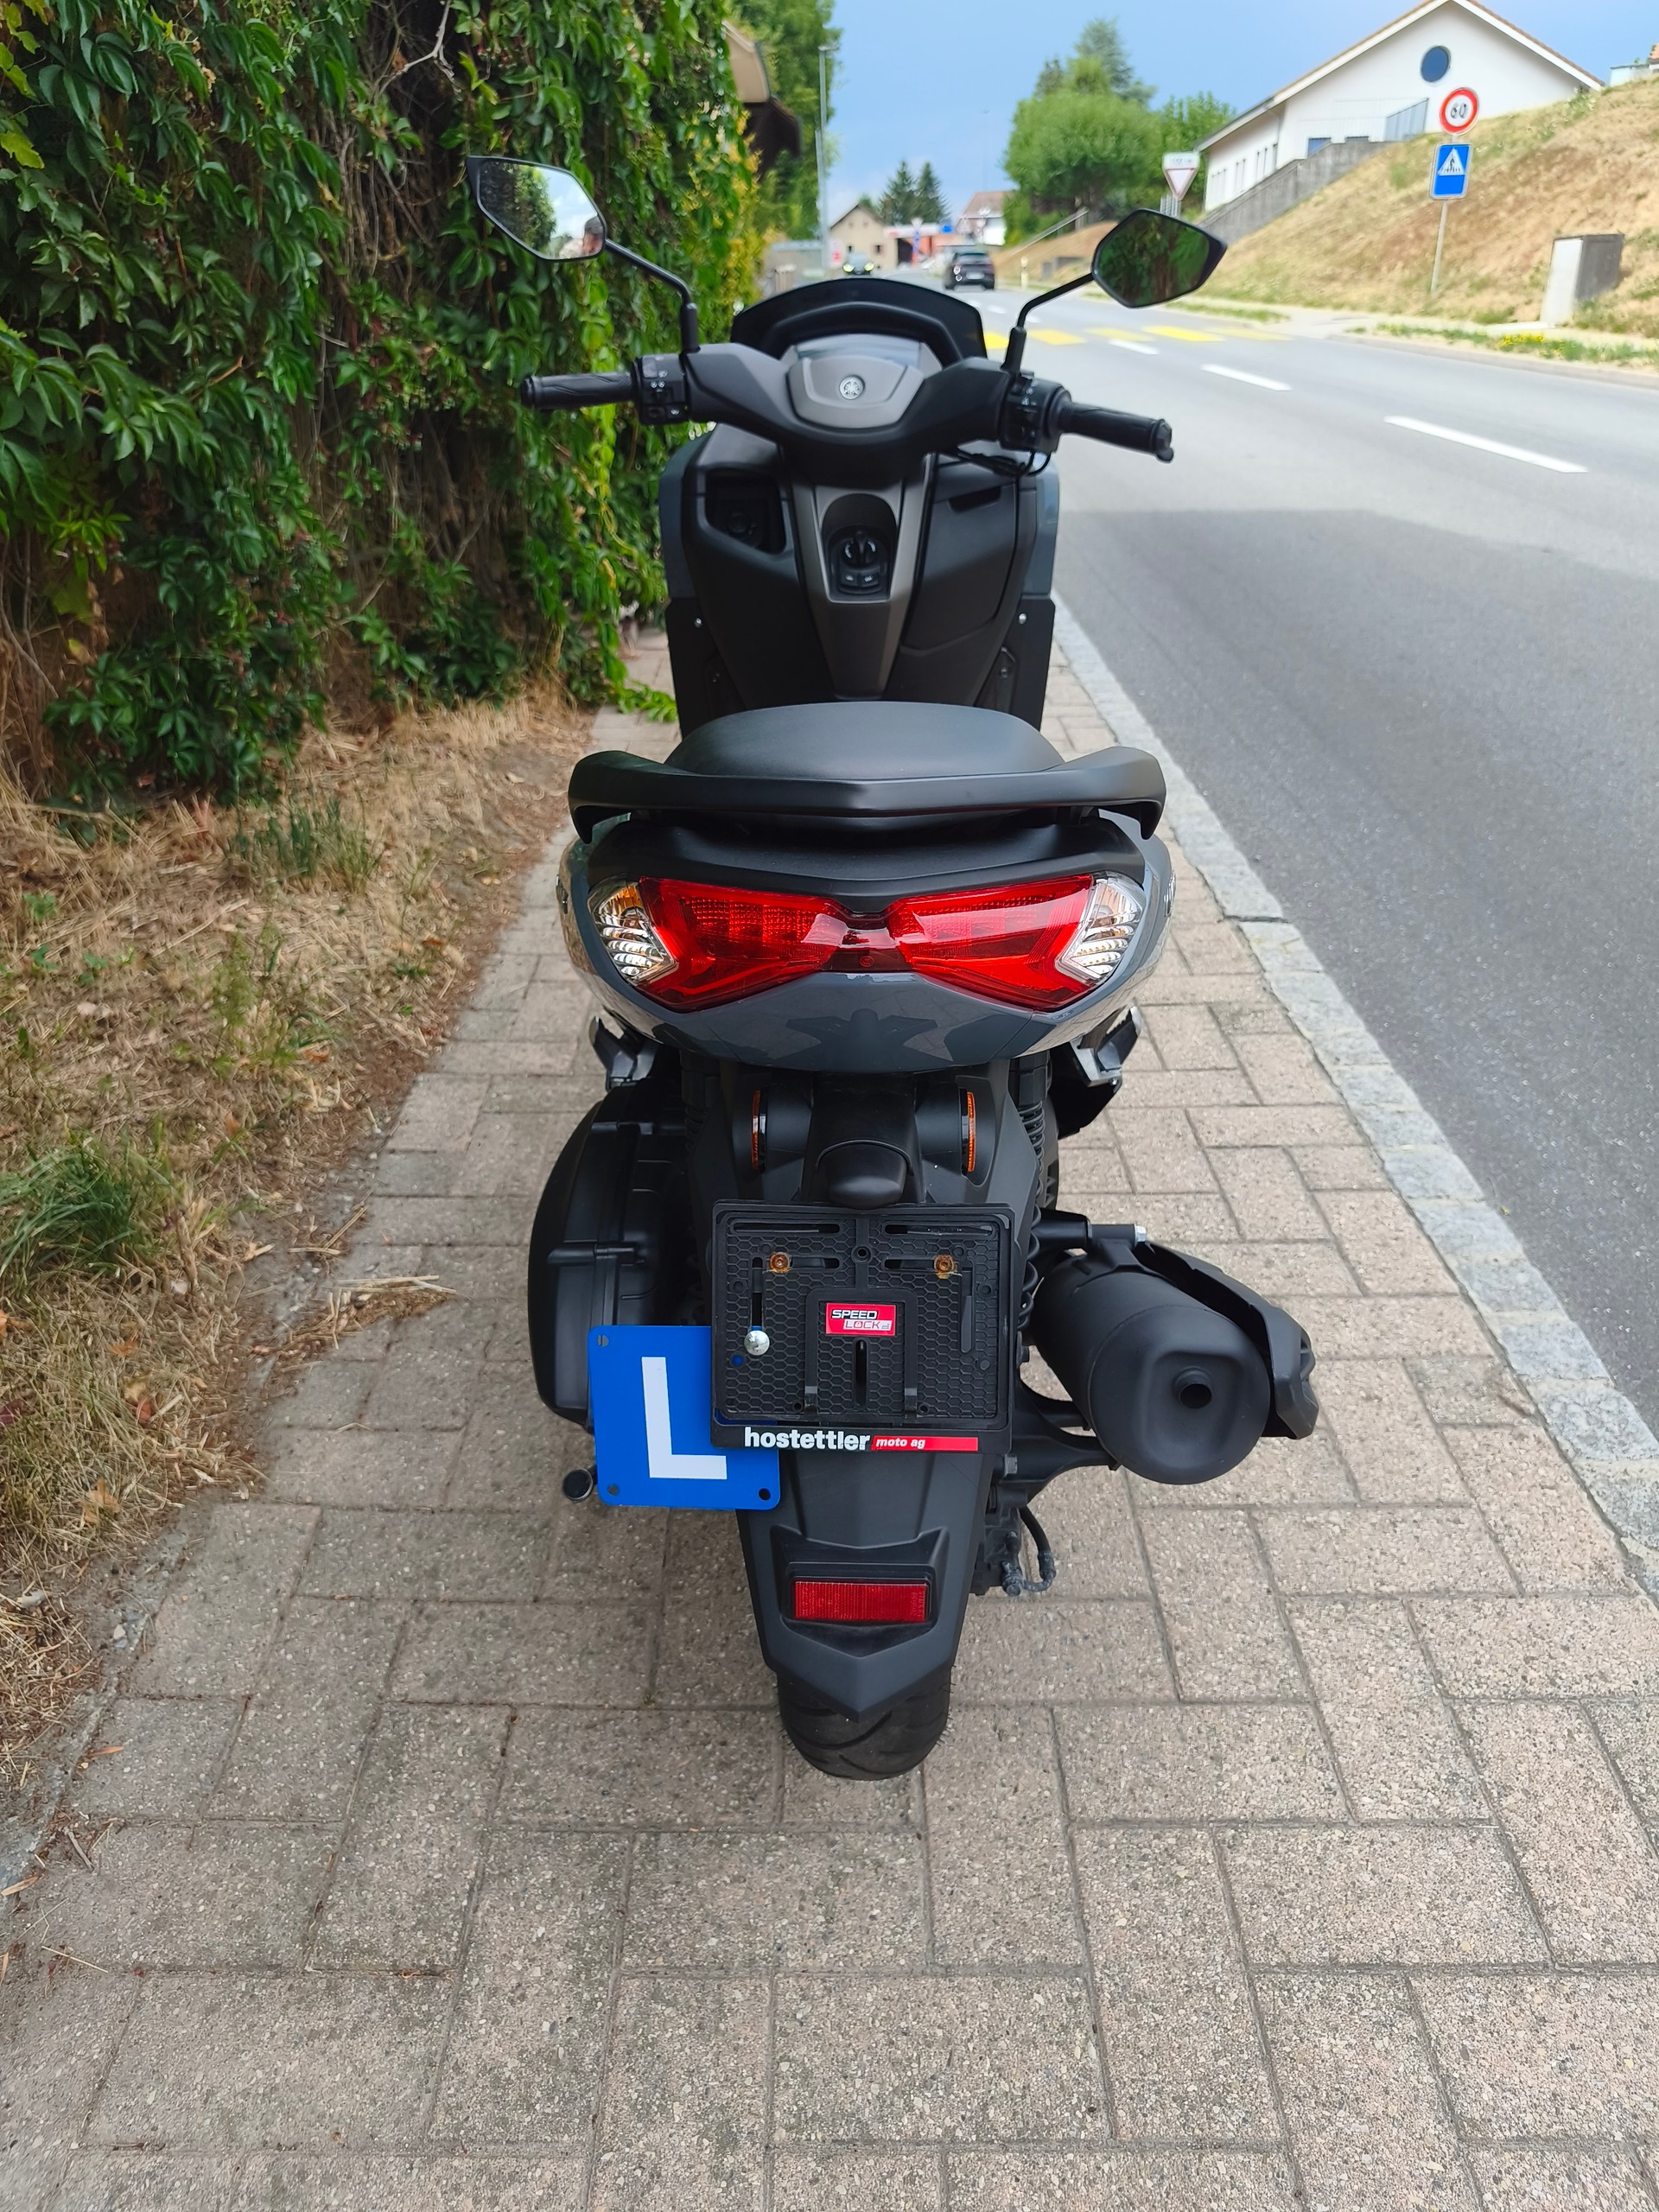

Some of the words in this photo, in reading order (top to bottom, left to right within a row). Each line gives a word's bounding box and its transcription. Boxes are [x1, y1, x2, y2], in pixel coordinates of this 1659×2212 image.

[1450, 103, 1467, 119] 60
[831, 1309, 878, 1319] SPEED
[845, 1320, 880, 1329] LOCK
[641, 1357, 727, 1479] L
[744, 1427, 870, 1450] hostettler
[875, 1438, 907, 1447] moto
[910, 1439, 925, 1449] ag
